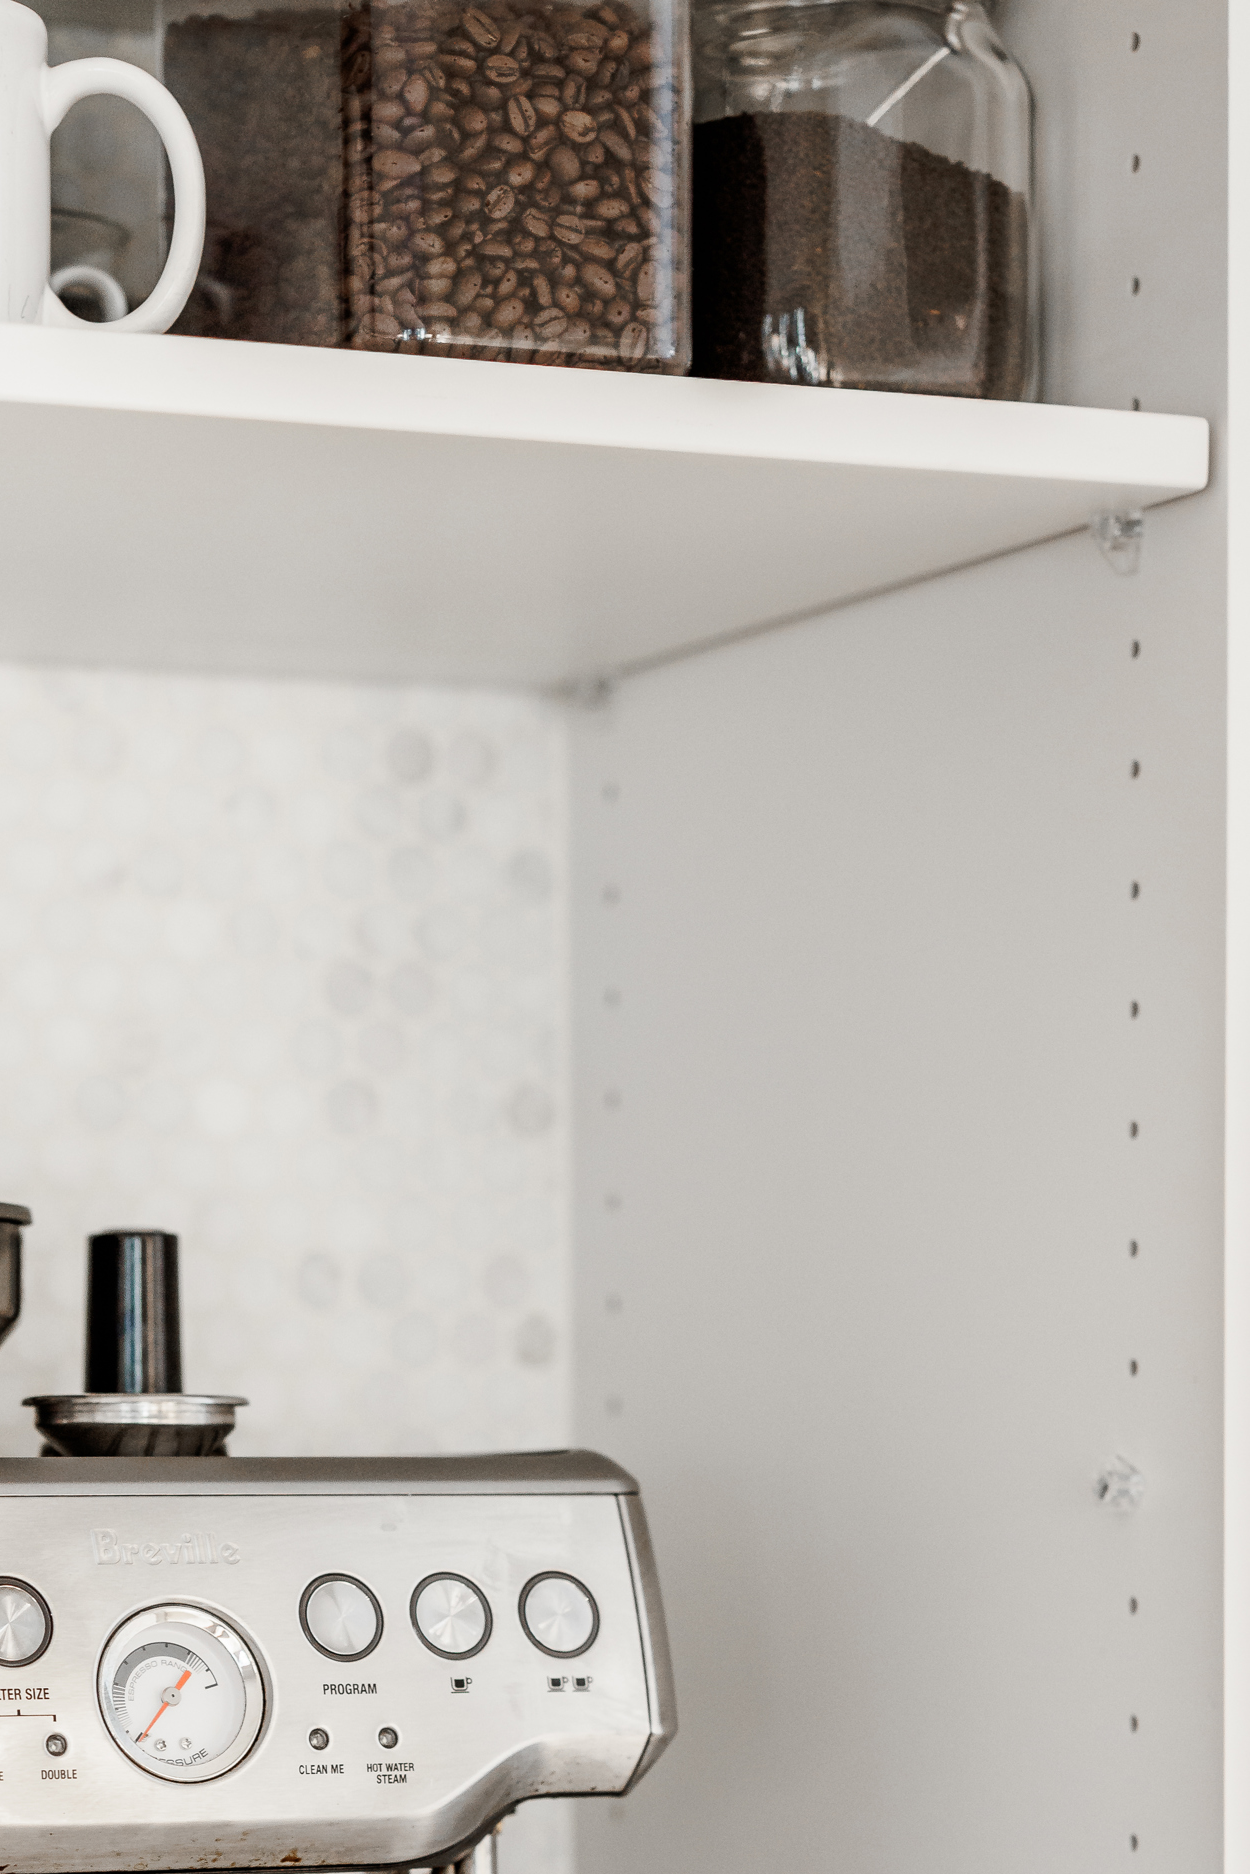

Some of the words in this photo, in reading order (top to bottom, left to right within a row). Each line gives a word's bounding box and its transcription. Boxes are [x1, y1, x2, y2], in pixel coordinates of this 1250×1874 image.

[90, 1528, 241, 1566] Breville
[128, 1660, 158, 1702] ESPRESSO
[160, 1659, 189, 1674] RANG
[25, 1687, 50, 1700] SIZE
[322, 1683, 378, 1695] PROGRAM
[298, 1764, 328, 1775] CLEAN
[330, 1763, 345, 1774] ME
[366, 1763, 383, 1772] HOT
[385, 1762, 415, 1772] WATER
[40, 1769, 78, 1780] DOUBLE
[376, 1774, 408, 1784] STEAM
